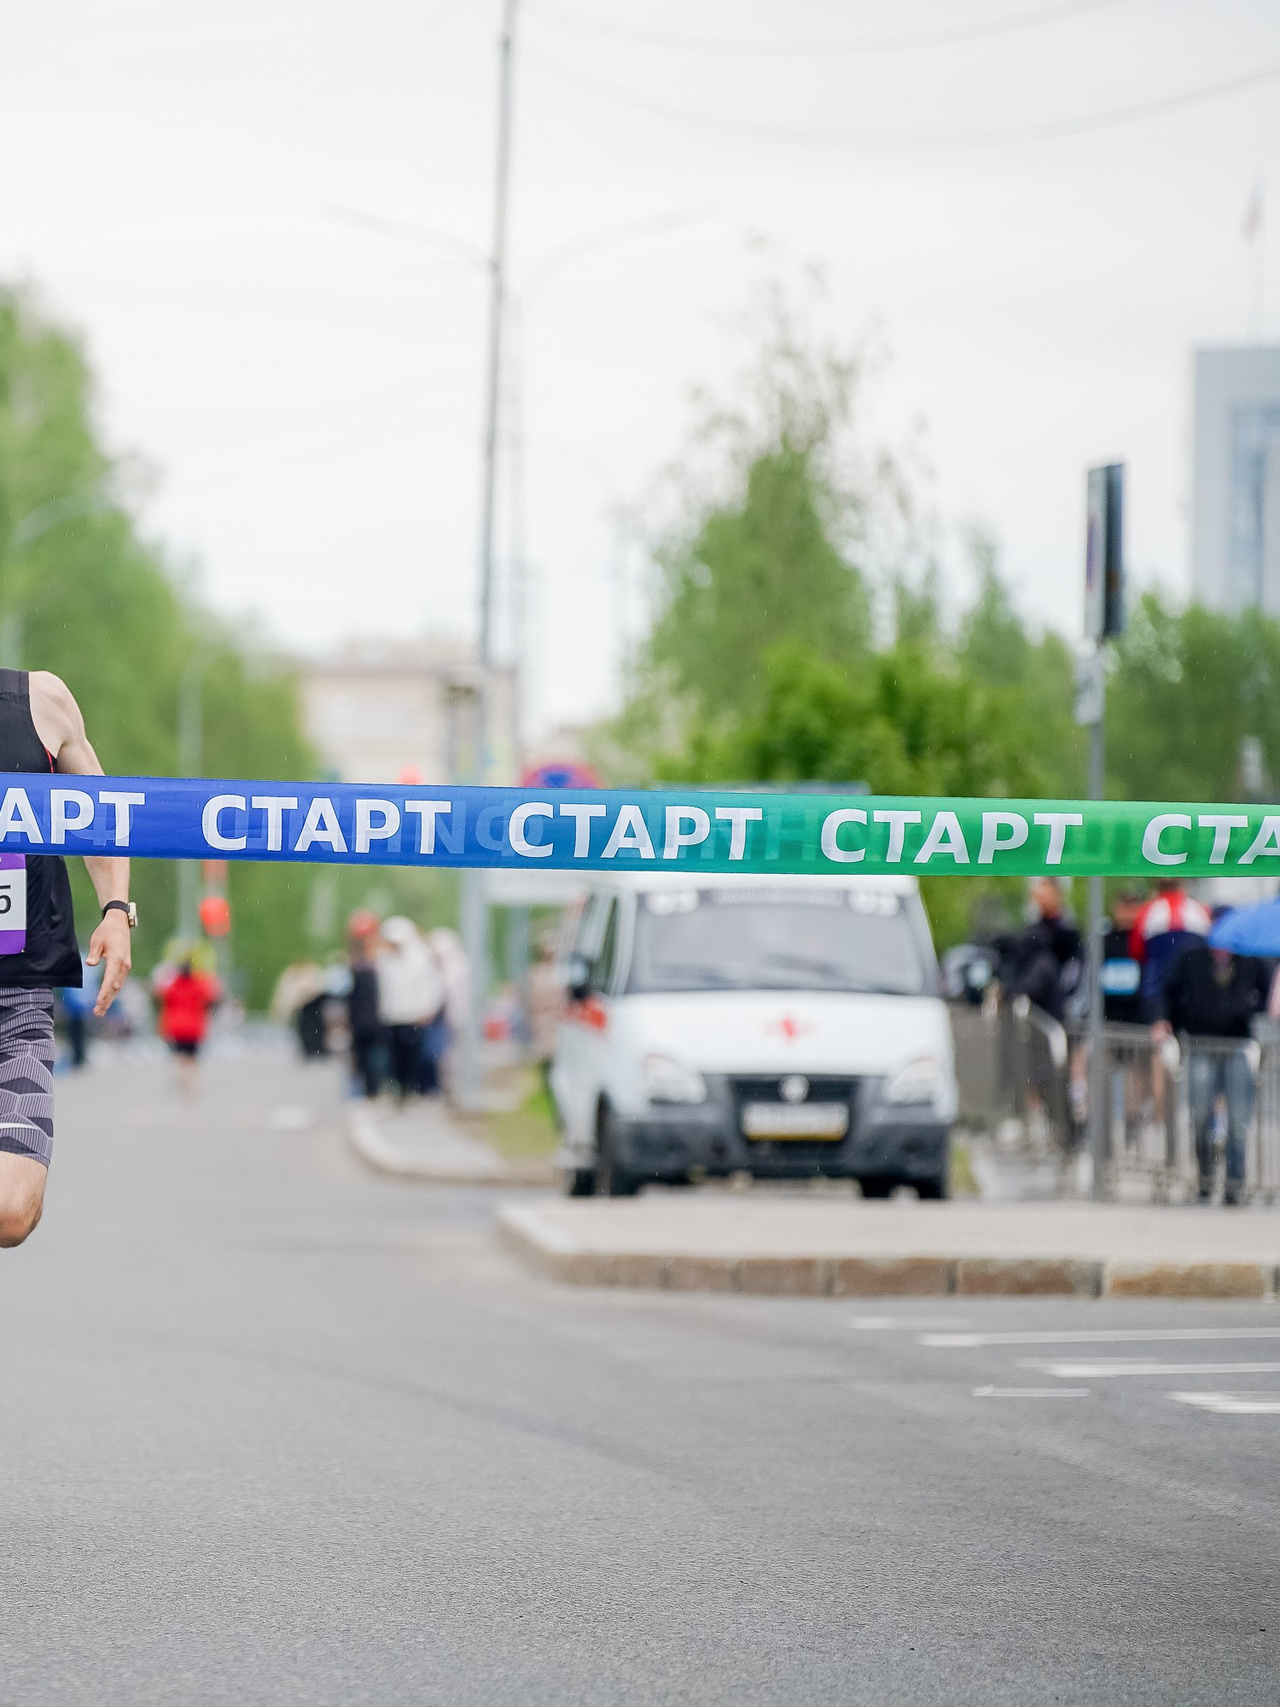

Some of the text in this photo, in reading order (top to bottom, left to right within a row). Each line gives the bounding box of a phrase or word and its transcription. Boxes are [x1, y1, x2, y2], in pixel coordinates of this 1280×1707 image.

[201, 794, 451, 854] СТАРТ
[508, 801, 762, 860] СТАРТ
[820, 808, 1083, 865] СТАРТ
